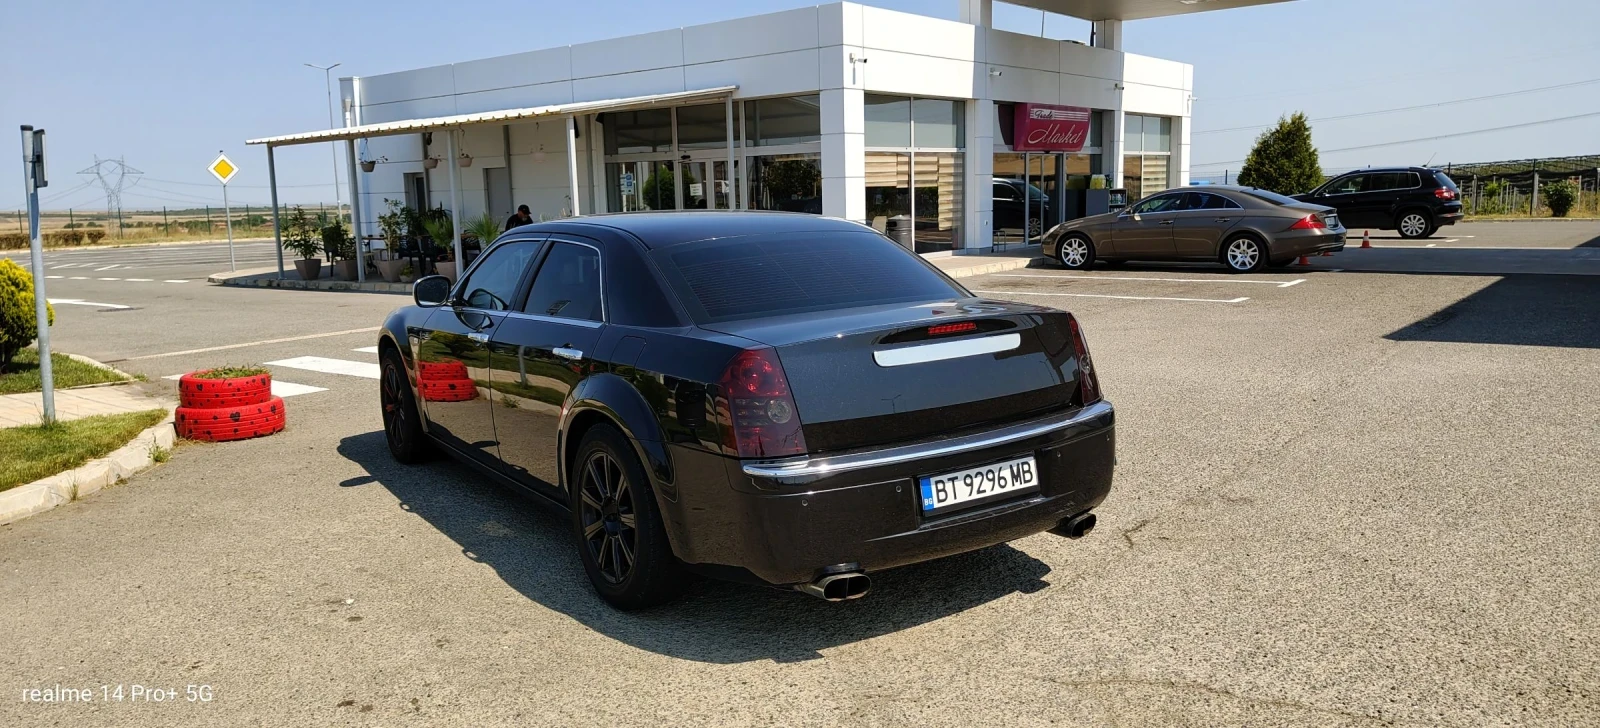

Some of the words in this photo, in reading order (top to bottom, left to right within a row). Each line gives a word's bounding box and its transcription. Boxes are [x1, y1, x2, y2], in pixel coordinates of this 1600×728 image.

[1027, 123, 1084, 144] Market
[935, 476, 959, 504] BT
[963, 466, 1008, 497] 9296
[1009, 461, 1034, 487] MB
[924, 498, 933, 506] BG
